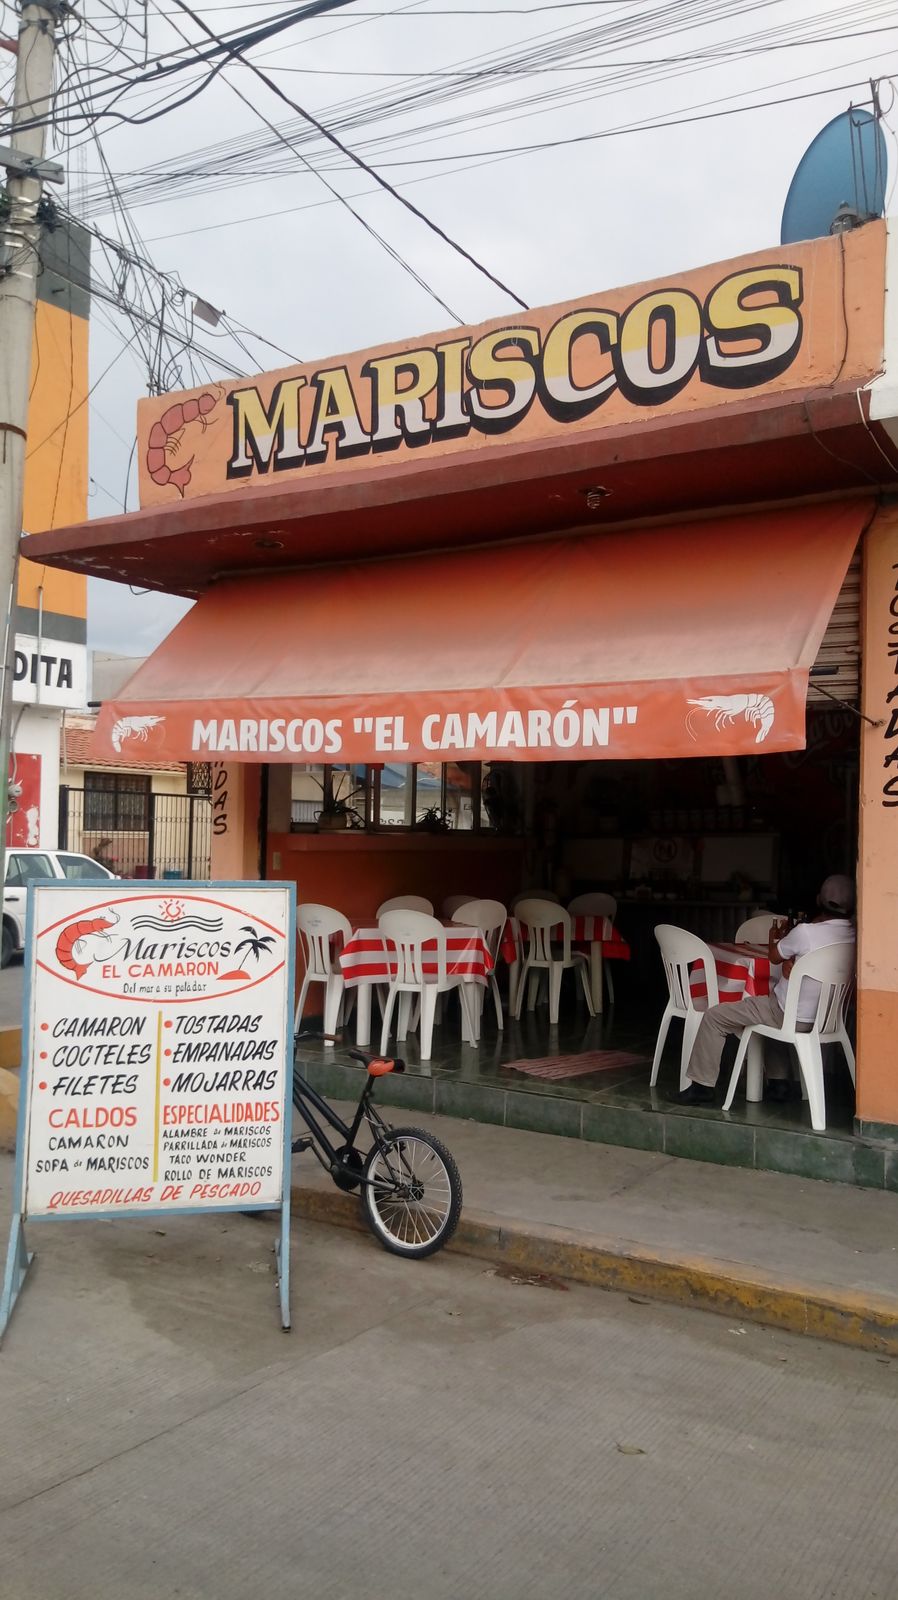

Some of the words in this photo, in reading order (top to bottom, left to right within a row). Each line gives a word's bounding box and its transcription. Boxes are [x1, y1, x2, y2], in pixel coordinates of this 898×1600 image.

[227, 264, 804, 479] MARISCOS
[191, 716, 343, 755] MARISCOS
[353, 713, 410, 753] "EL
[421, 699, 638, 752] CAMARÓN"
[213, 761, 228, 835] DAS
[94, 937, 232, 962] Mariscos
[102, 964, 121, 979] EL
[128, 961, 219, 978] CAMARON
[123, 982, 137, 994] Del
[139, 985, 154, 994] mar
[156, 985, 161, 993] a
[164, 984, 172, 993] su
[175, 980, 207, 997] paladar
[52, 1016, 147, 1038] CAMARON
[175, 1015, 263, 1035] TOSTADAS
[52, 1043, 152, 1067] COCTELES
[172, 1040, 279, 1063] EMPANADAS
[52, 1074, 139, 1096] FILETES
[171, 1069, 279, 1093] MOJARRAS
[48, 1106, 138, 1128] CALDOS
[163, 1101, 280, 1125] ESPECIALIDADES
[48, 1134, 129, 1151] CAMARON
[162, 1127, 208, 1138] ALAMBRE
[224, 1125, 272, 1136] MARISCOS
[163, 1139, 218, 1151] PARRILLADA
[229, 1137, 272, 1149] MARISCOS
[35, 1158, 69, 1173] SOPA
[86, 1156, 150, 1173] MARISCOS
[169, 1153, 192, 1164] TACO
[196, 1151, 247, 1163] WONDER
[164, 1169, 193, 1181] ROLLO
[199, 1168, 212, 1180] DE
[217, 1165, 273, 1179] MARISCOS
[46, 1187, 155, 1209] QUESADILLAS
[159, 1184, 184, 1201] DE
[189, 1181, 262, 1199] PESCADO
